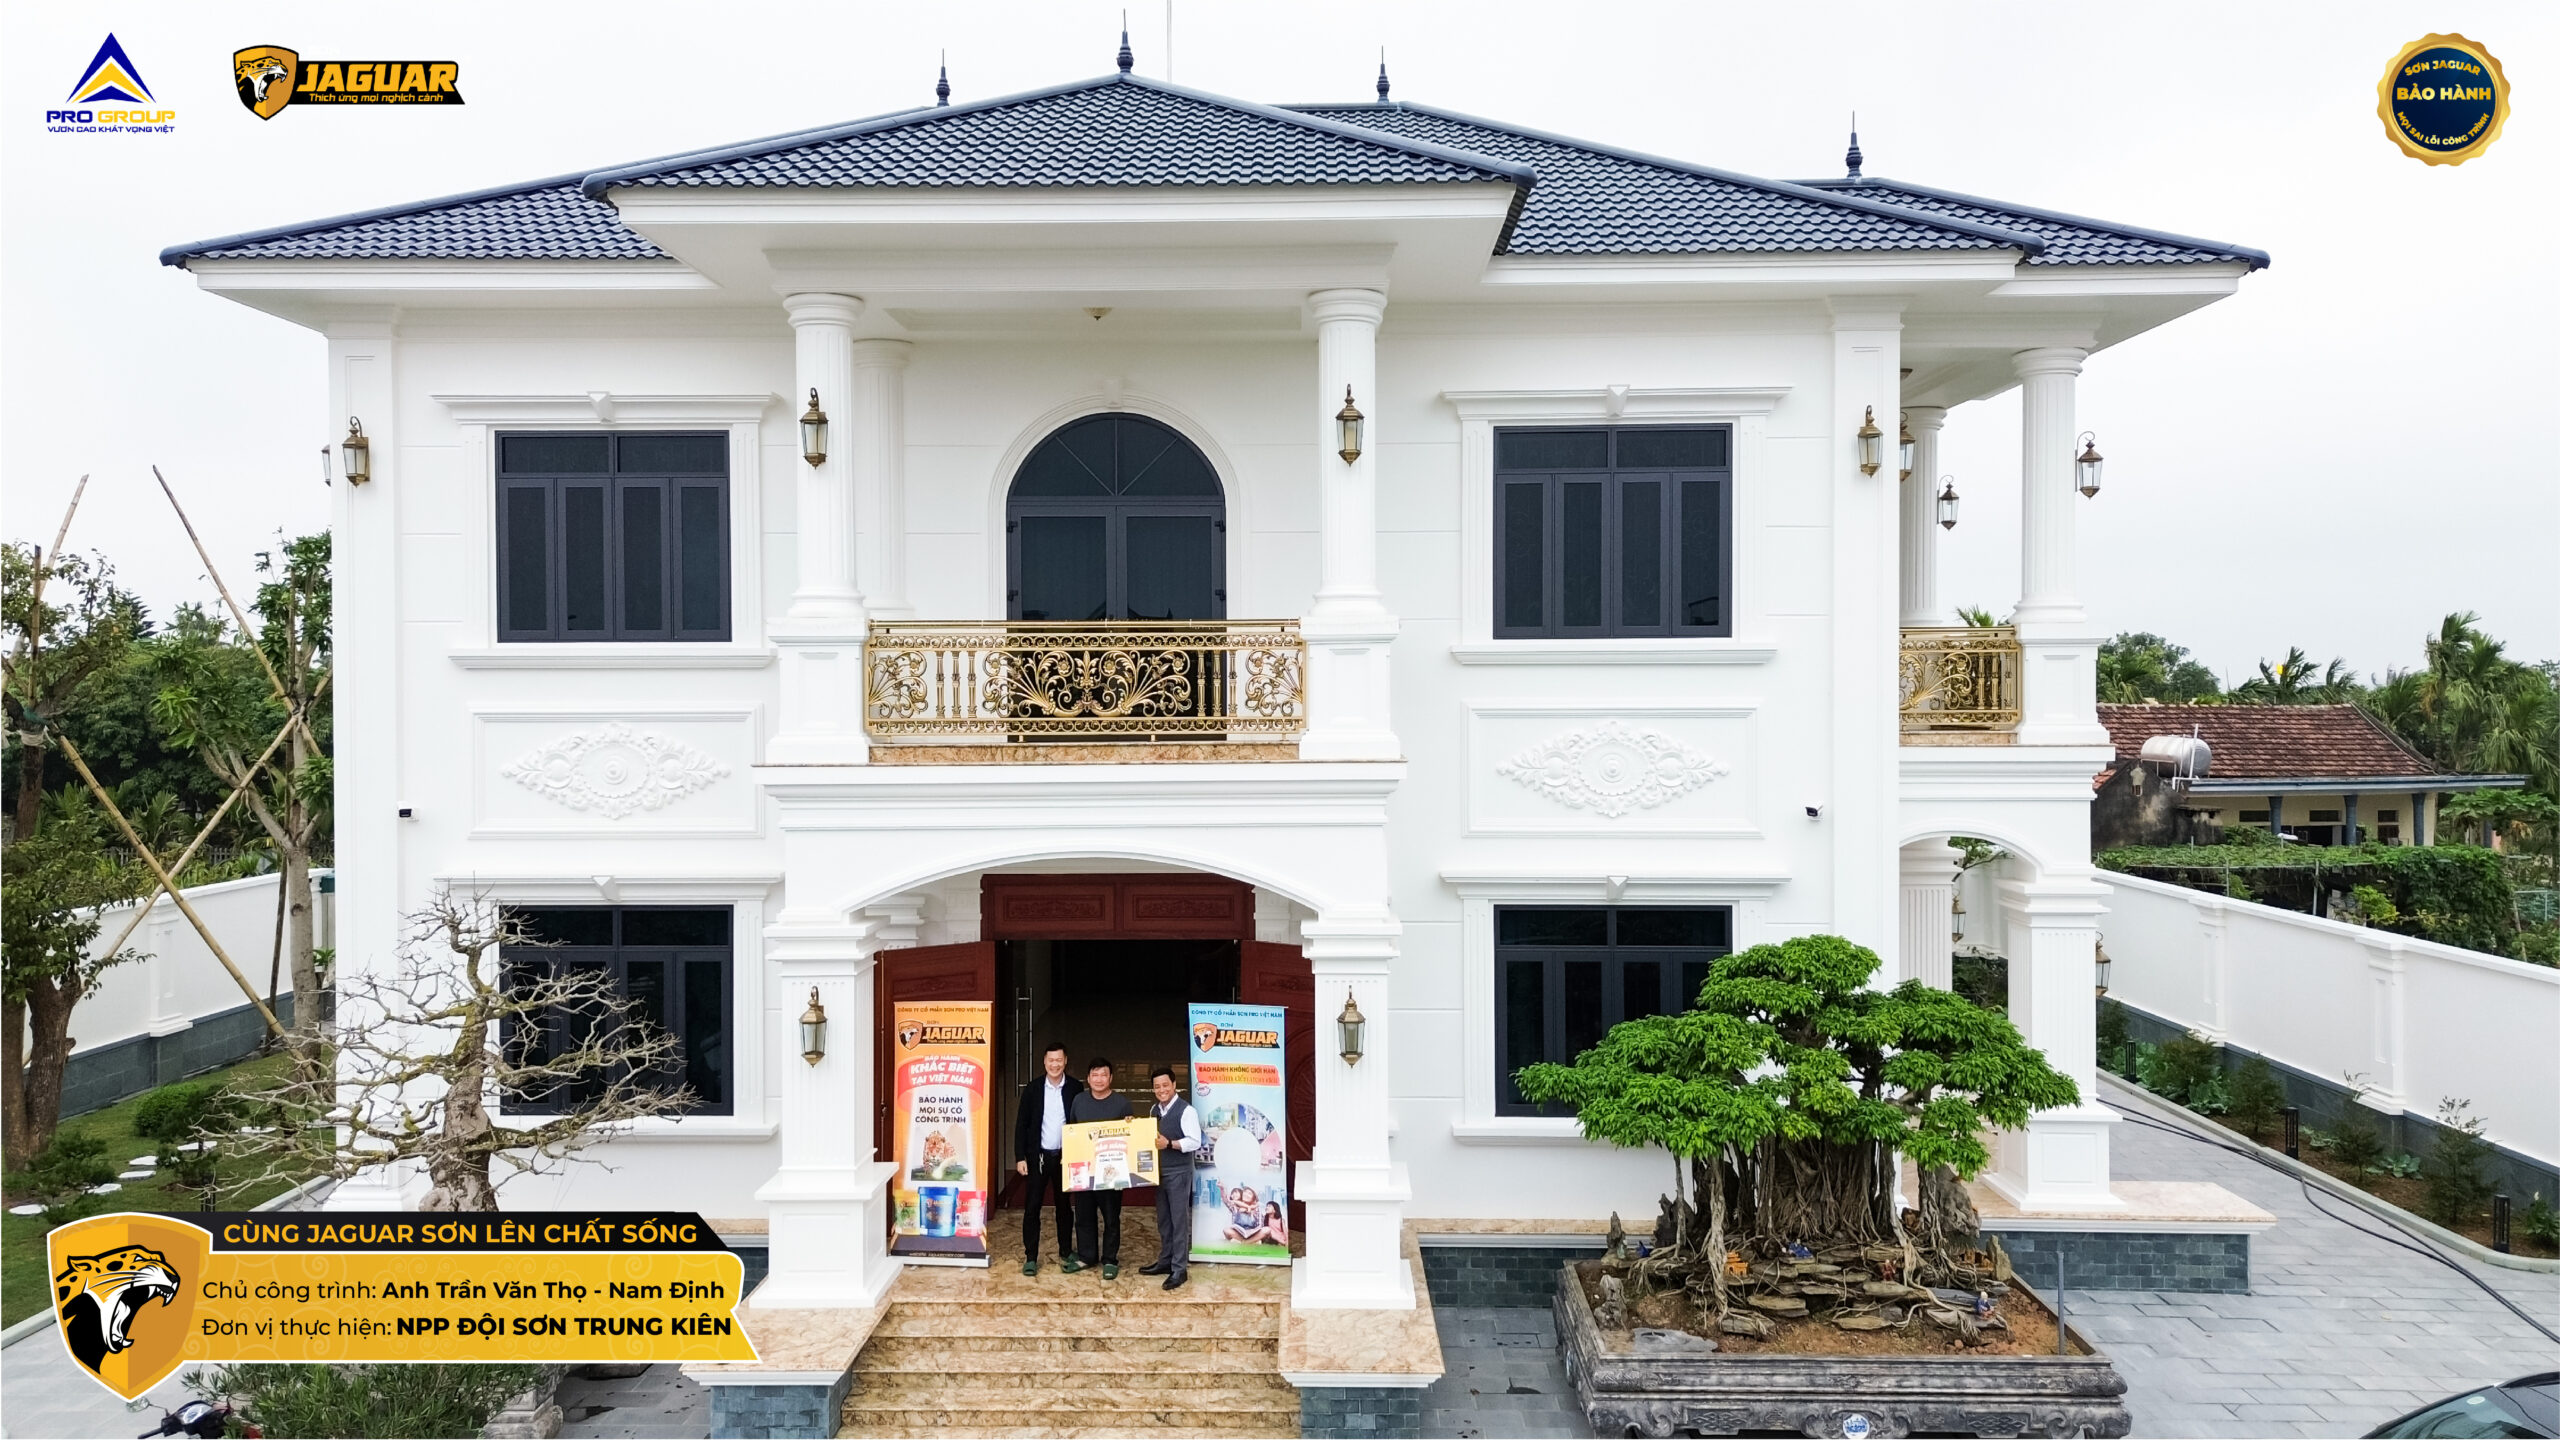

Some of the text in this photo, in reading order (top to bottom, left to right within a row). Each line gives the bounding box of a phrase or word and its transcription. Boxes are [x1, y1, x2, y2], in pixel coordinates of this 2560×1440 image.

[922, 1027, 984, 1040] JAGUAR
[1217, 1030, 1278, 1044] JAGUAR
[911, 1060, 977, 1075] KHÁC BIỆT
[911, 1073, 973, 1086] TẠI VIỆT NAM
[919, 1106, 935, 1115] MỌI
